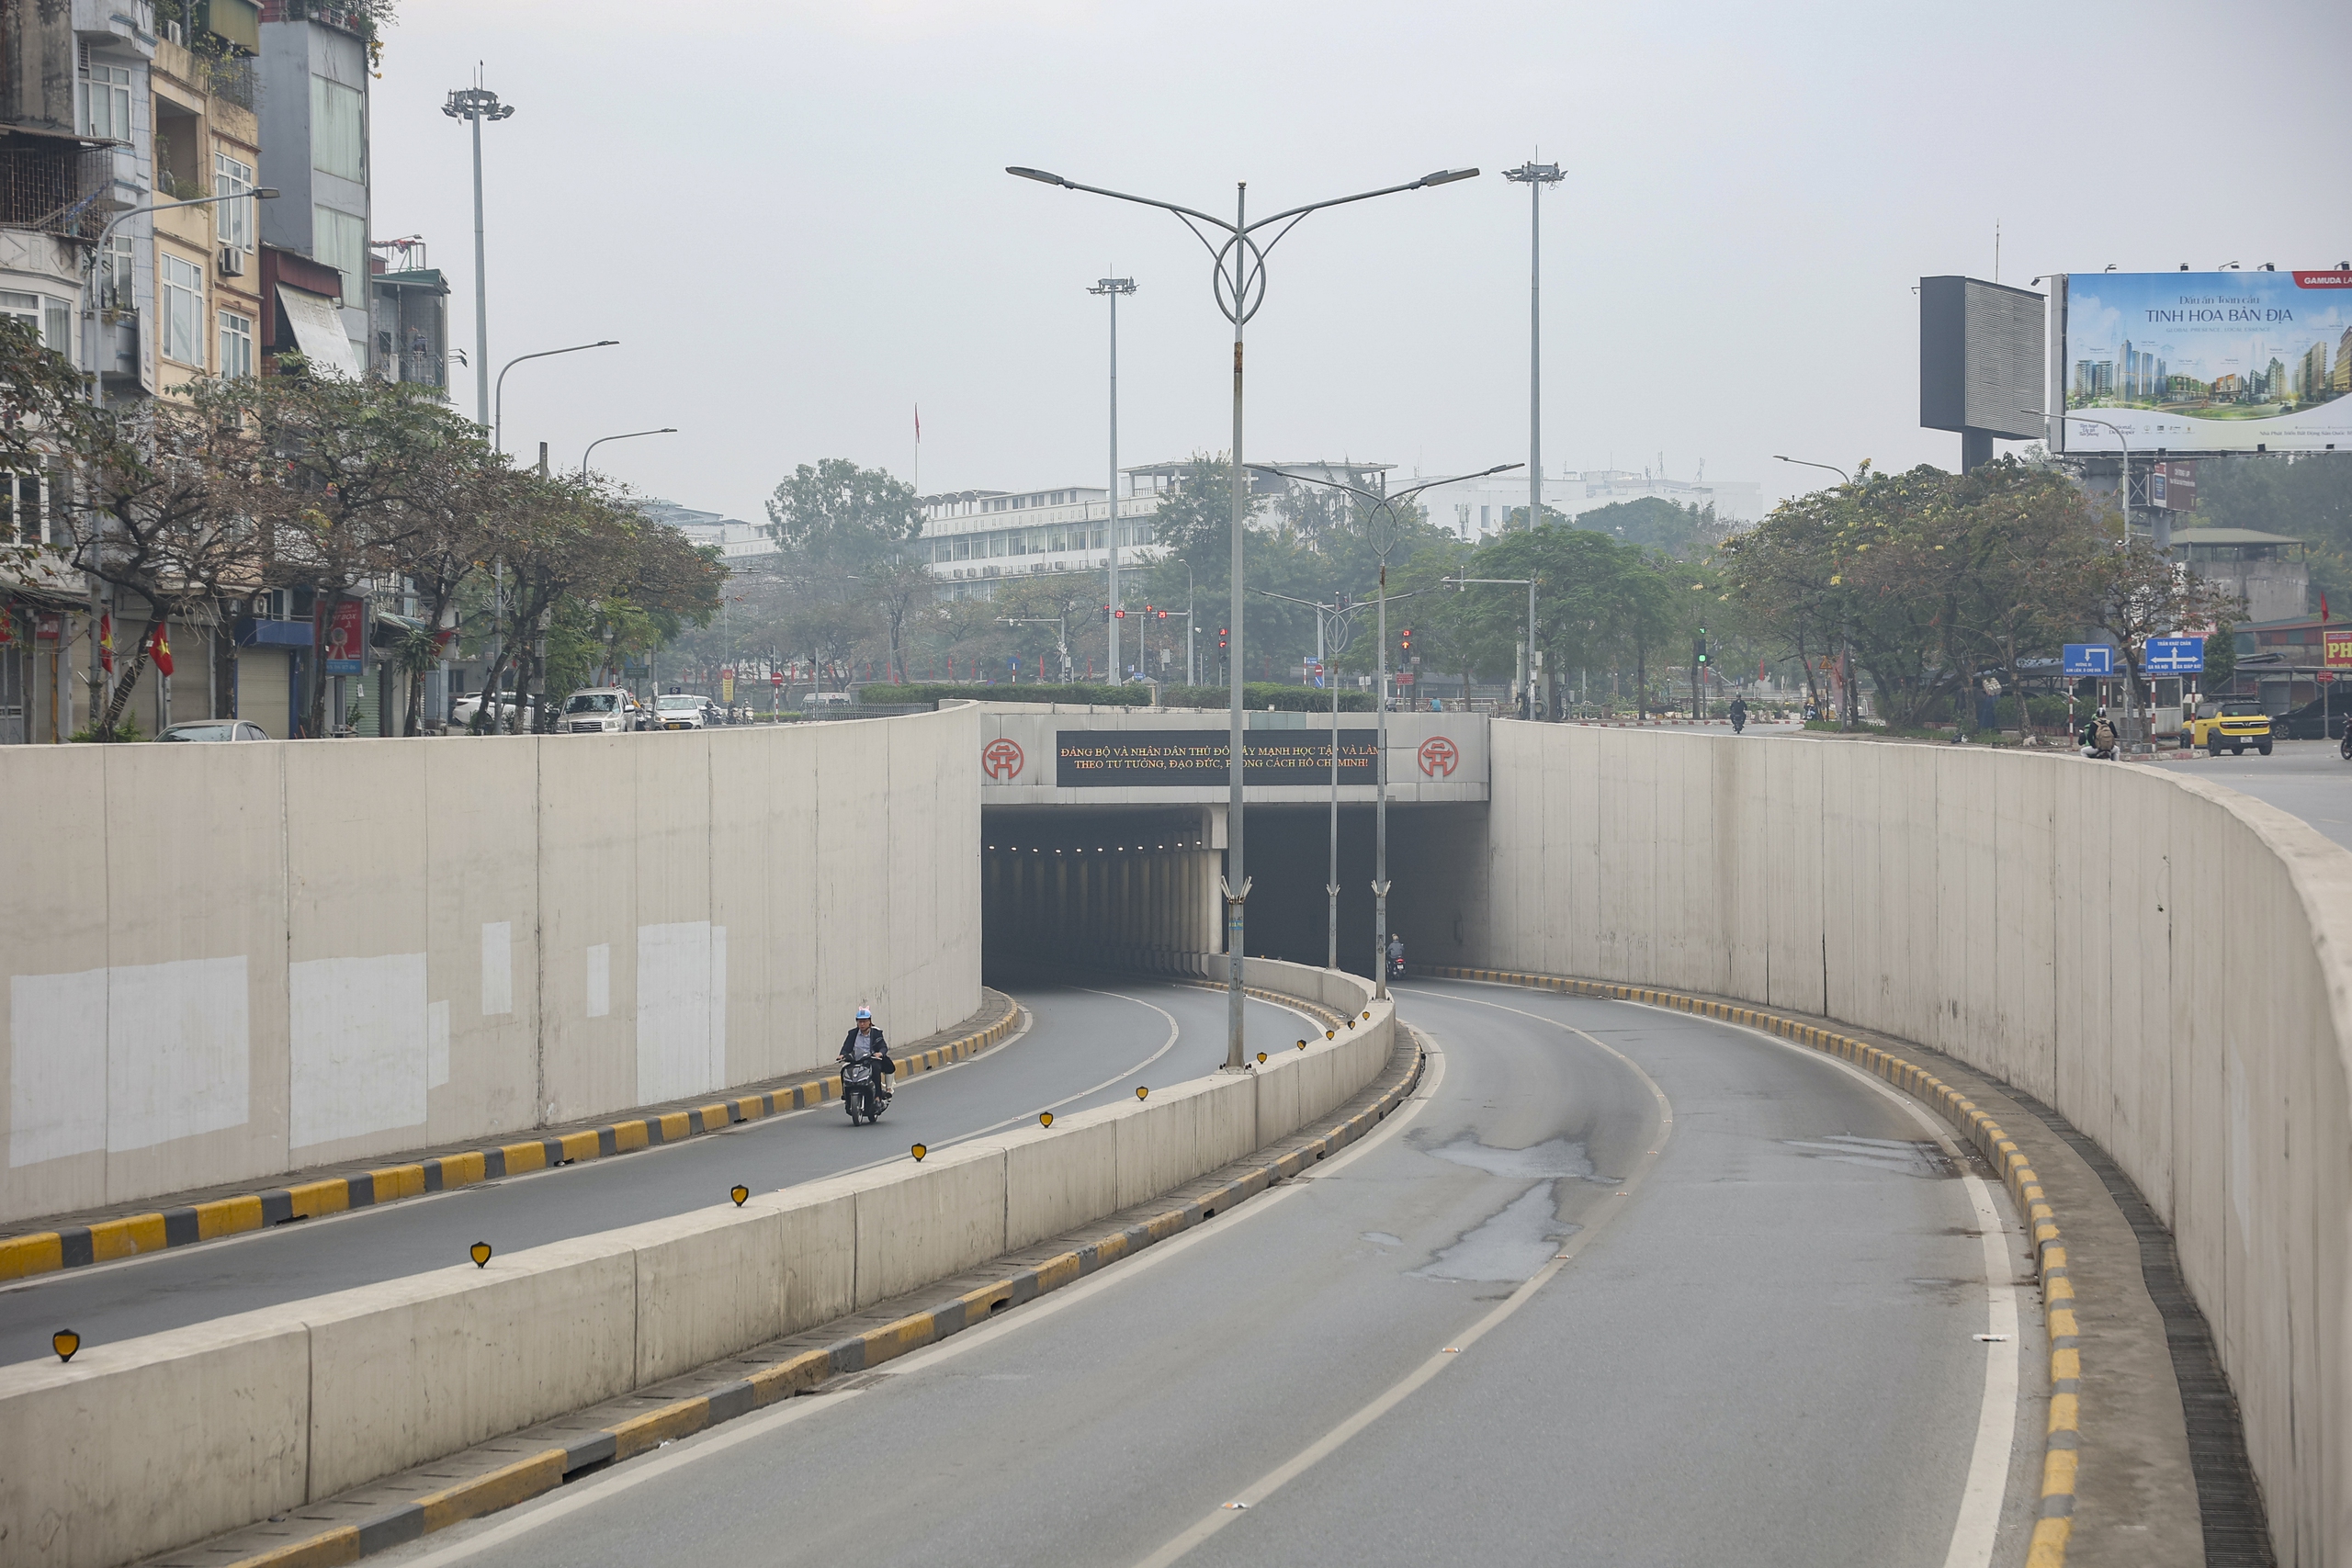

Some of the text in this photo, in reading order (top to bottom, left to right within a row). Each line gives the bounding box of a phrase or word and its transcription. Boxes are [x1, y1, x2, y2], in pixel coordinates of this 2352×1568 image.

[2304, 276, 2342, 285] GAMUDA
[2179, 295, 2199, 305] Dấu
[2216, 294, 2241, 304] Toàn
[2145, 306, 2293, 323] TINH HOA BẢN ĐỊA
[1060, 746, 1093, 757] ĐẢNG
[1094, 745, 1111, 758] BỘ
[1113, 745, 1129, 756] VÀ
[1131, 745, 1161, 756] NHÂN
[1163, 745, 1186, 756] DÂN
[1189, 745, 1211, 756] THỦ
[1213, 745, 1230, 756] ĐÔ
[1258, 747, 1290, 757] MẠNH
[1292, 746, 1316, 757] HỌC
[1317, 744, 1339, 757] TẬ
[1342, 744, 1357, 755] VÀ
[1074, 760, 1104, 769] THEO
[1105, 760, 1123, 769] TƯ
[1169, 760, 1193, 770] ĐẠO
[1195, 758, 1224, 770] ĐỨC,
[1225, 759, 1263, 768] PONG
[1265, 758, 1296, 768] CÁCH
[1317, 758, 1333, 767] CH
[1338, 758, 1369, 767] MINH!
